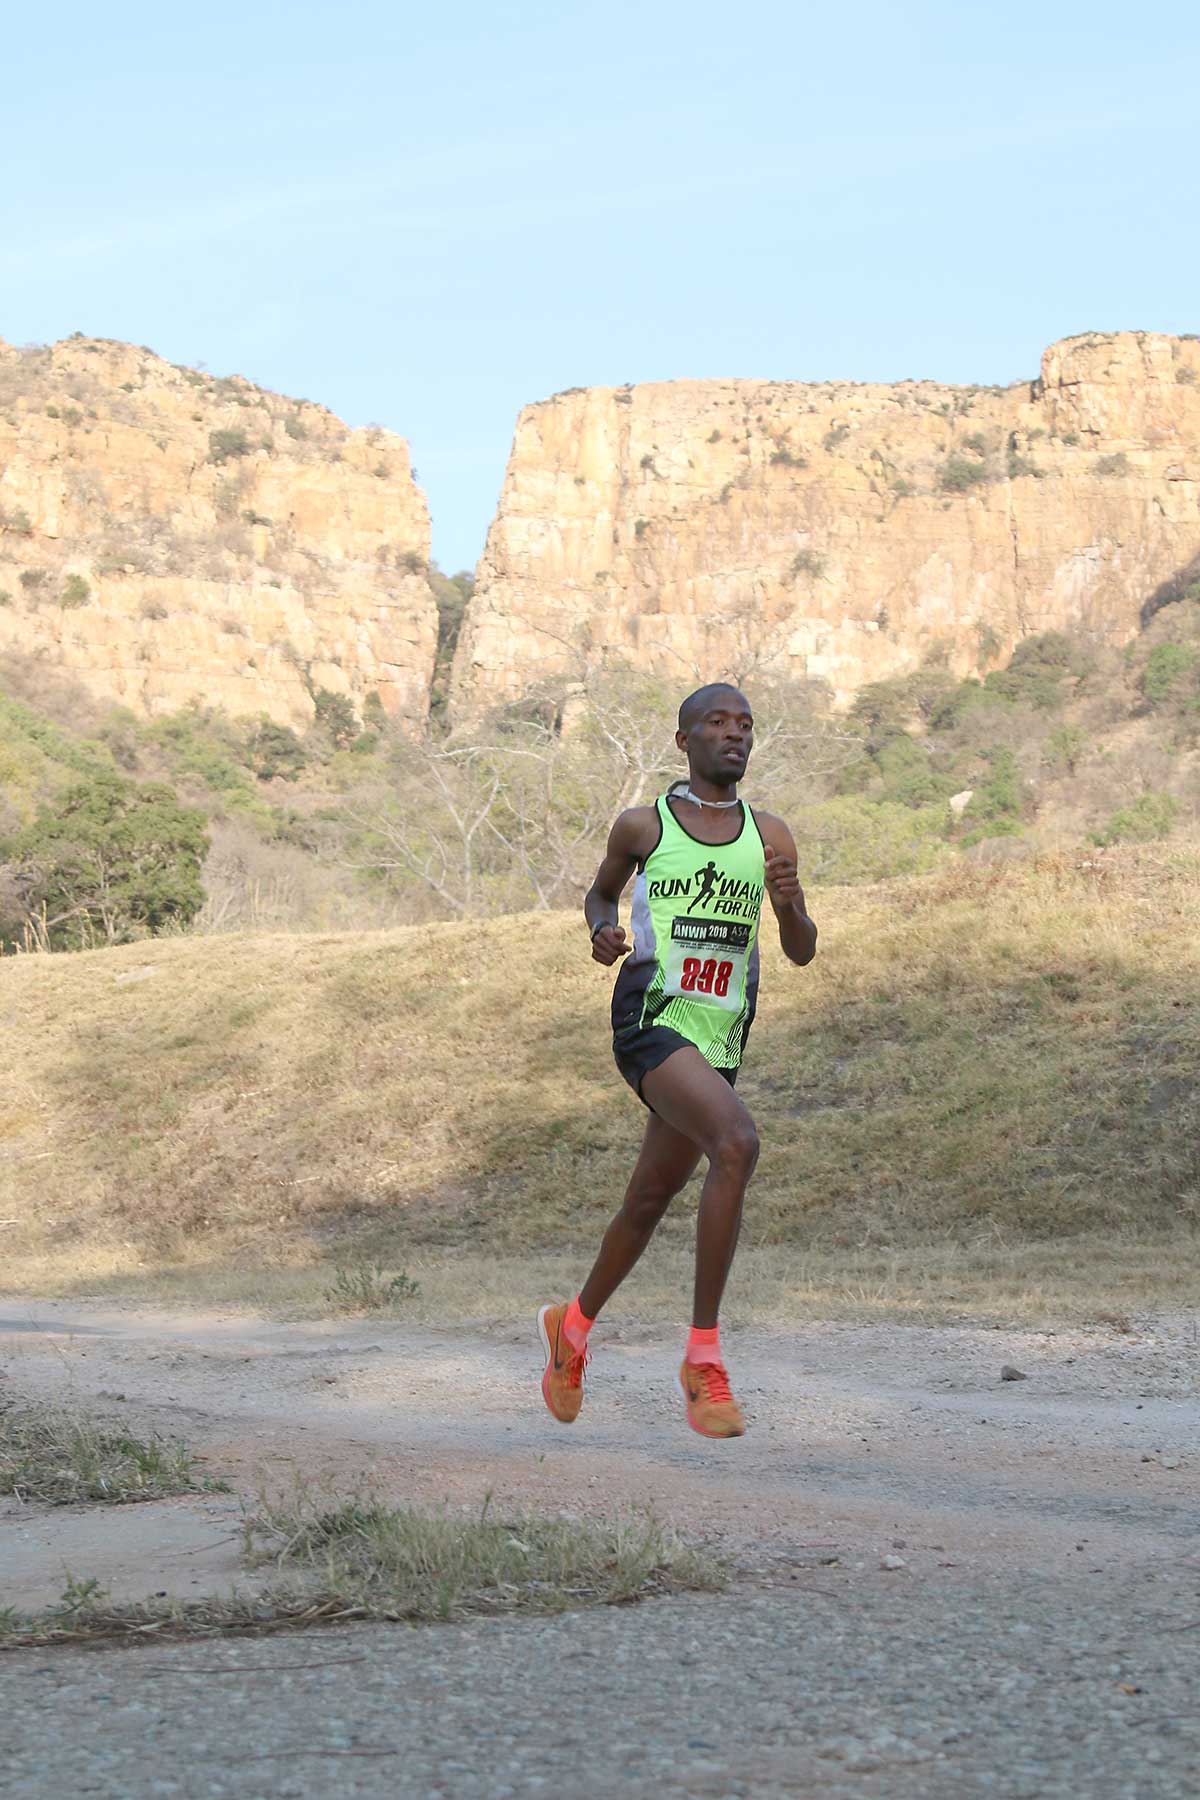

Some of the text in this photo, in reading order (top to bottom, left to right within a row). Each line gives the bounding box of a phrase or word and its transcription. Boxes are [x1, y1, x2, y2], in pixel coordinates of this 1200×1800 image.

[649, 879, 763, 903] RUN WALK
[713, 900, 742, 915] FOR
[673, 925, 728, 939] ANWN 2018
[731, 926, 748, 937] ASA
[681, 957, 734, 997] 898
